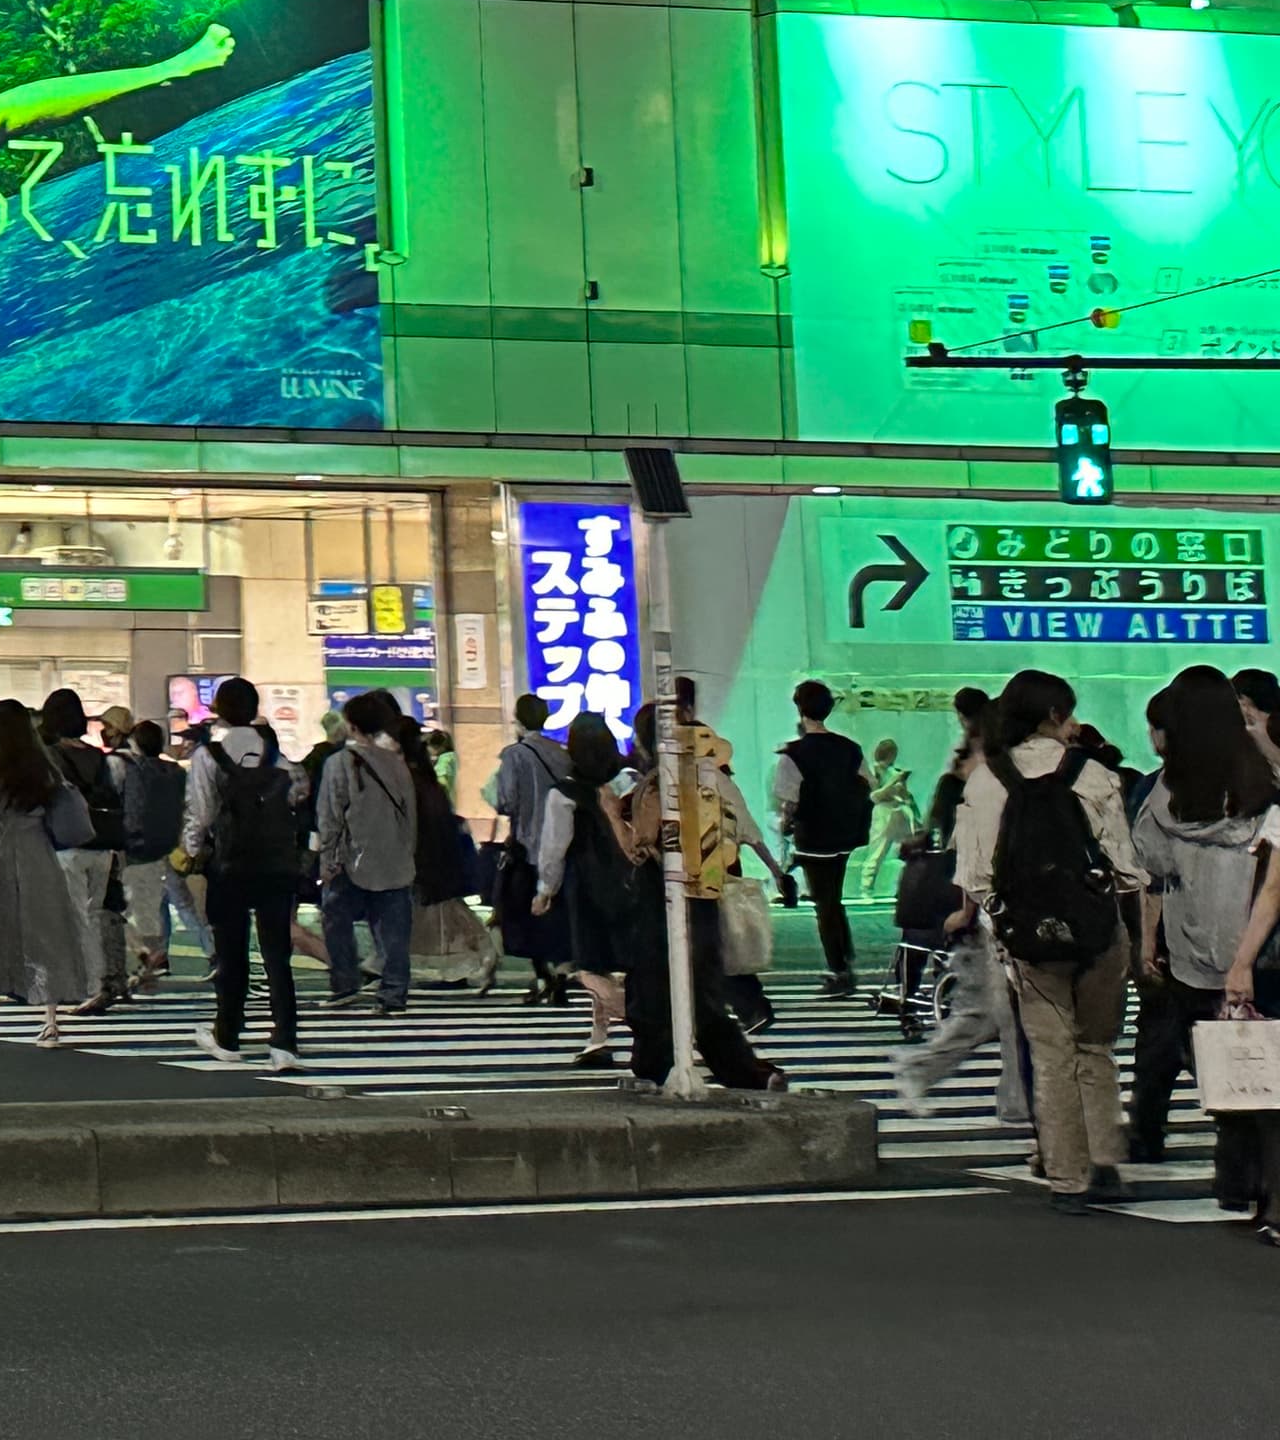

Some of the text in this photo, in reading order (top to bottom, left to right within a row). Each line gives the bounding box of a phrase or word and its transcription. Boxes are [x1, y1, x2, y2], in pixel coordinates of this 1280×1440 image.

[997, 528, 1251, 562] みどりの窓口
[531, 551, 586, 730] ステップ
[1002, 611, 1104, 639] VIEW
[1127, 613, 1256, 640] ALTTE
